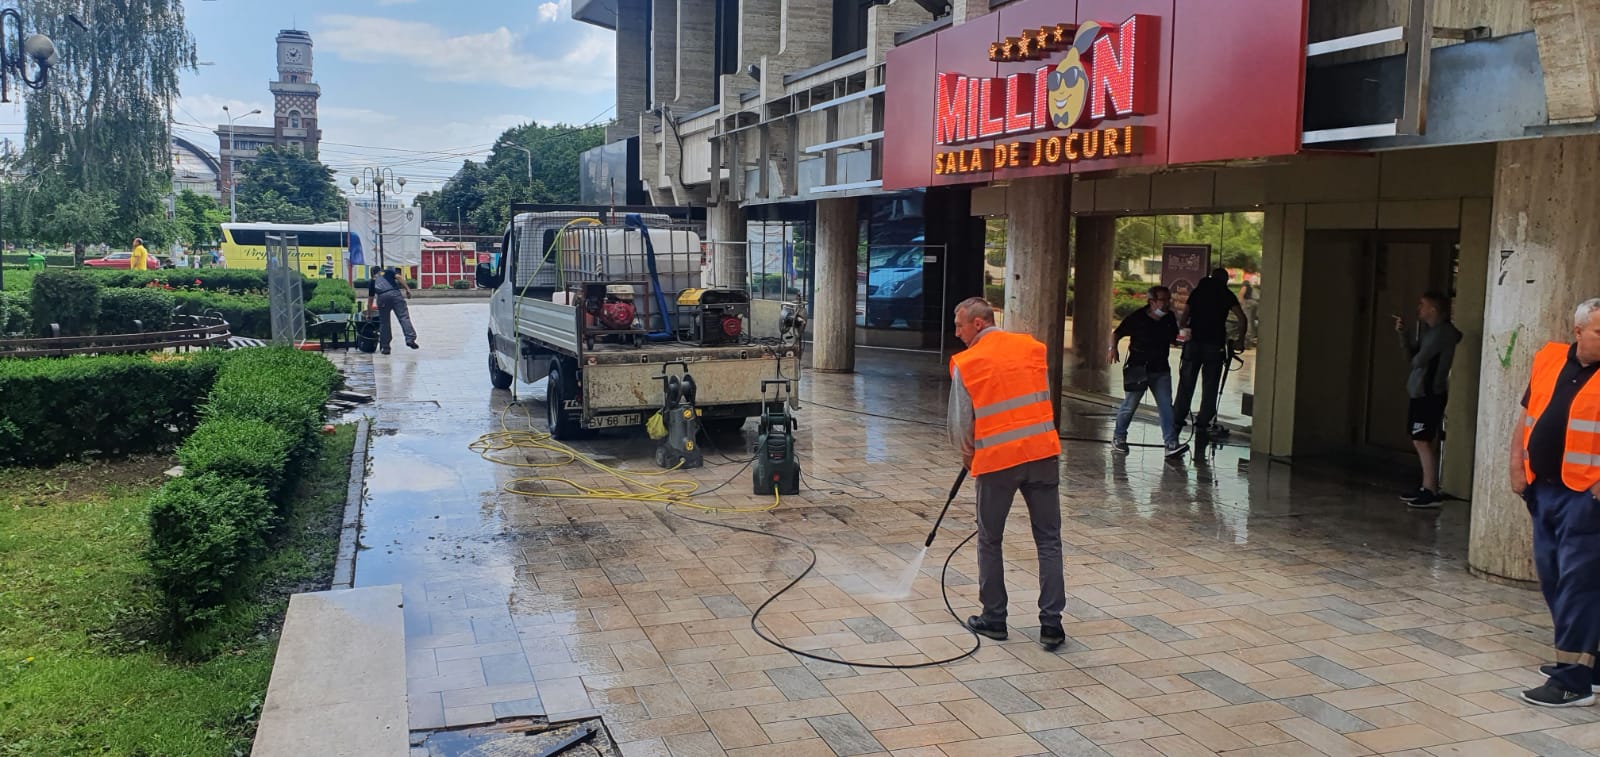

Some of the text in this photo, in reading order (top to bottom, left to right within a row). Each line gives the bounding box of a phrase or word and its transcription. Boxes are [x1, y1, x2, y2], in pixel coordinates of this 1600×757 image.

[935, 126, 1132, 175] SALA DE JOCURI
